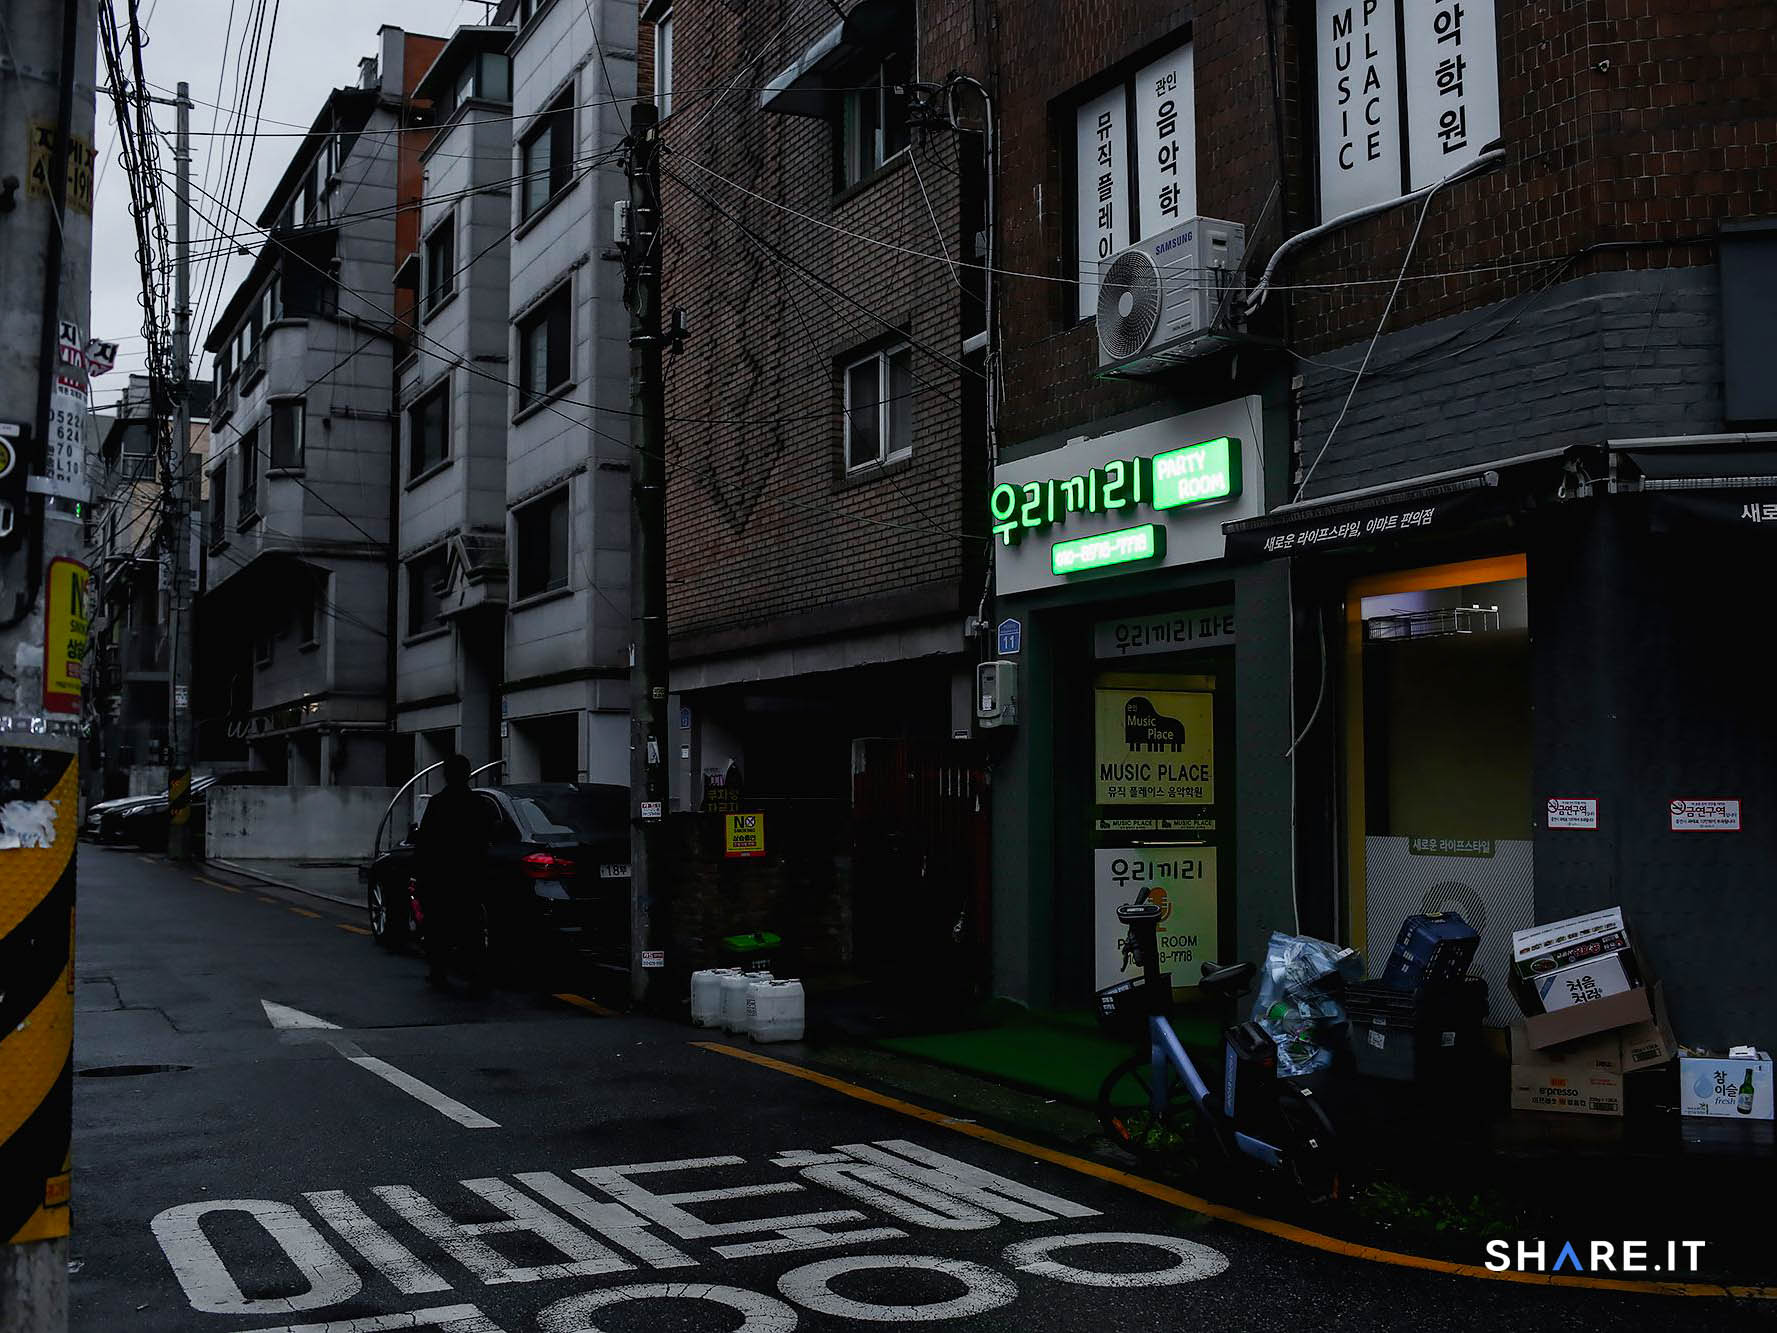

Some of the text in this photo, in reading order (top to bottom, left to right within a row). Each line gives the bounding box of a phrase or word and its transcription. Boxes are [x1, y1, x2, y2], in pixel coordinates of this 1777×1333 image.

[1156, 71, 1177, 97] 관인
[1333, 8, 1353, 170] MUSIC
[1363, 0, 1381, 161] PLACE
[1433, 0, 1467, 155] 악학원
[1155, 231, 1193, 256] SAMSUNG
[1157, 450, 1206, 480] PARTY
[1178, 472, 1225, 498] ROOM
[991, 456, 1140, 545] 우리끼리
[1264, 507, 1435, 551] 새로운 라이프스타일, 이마트 편의점
[1003, 635, 1015, 649] 11
[1115, 625, 1193, 654] 우리끼리
[1127, 715, 1157, 727] Music
[1148, 728, 1175, 740] Place
[1100, 764, 1209, 782] MUSIC PLACE
[1108, 786, 1203, 798] 뮤직 플레이스 음악학원
[1413, 838, 1490, 854] 새로운 라이프스타일
[1112, 859, 1202, 887] 우리끼리
[1162, 936, 1198, 948] ROOM
[1566, 975, 1596, 993] 처음
[1714, 1071, 1728, 1085] 참
[1715, 1084, 1738, 1098] 이슬
